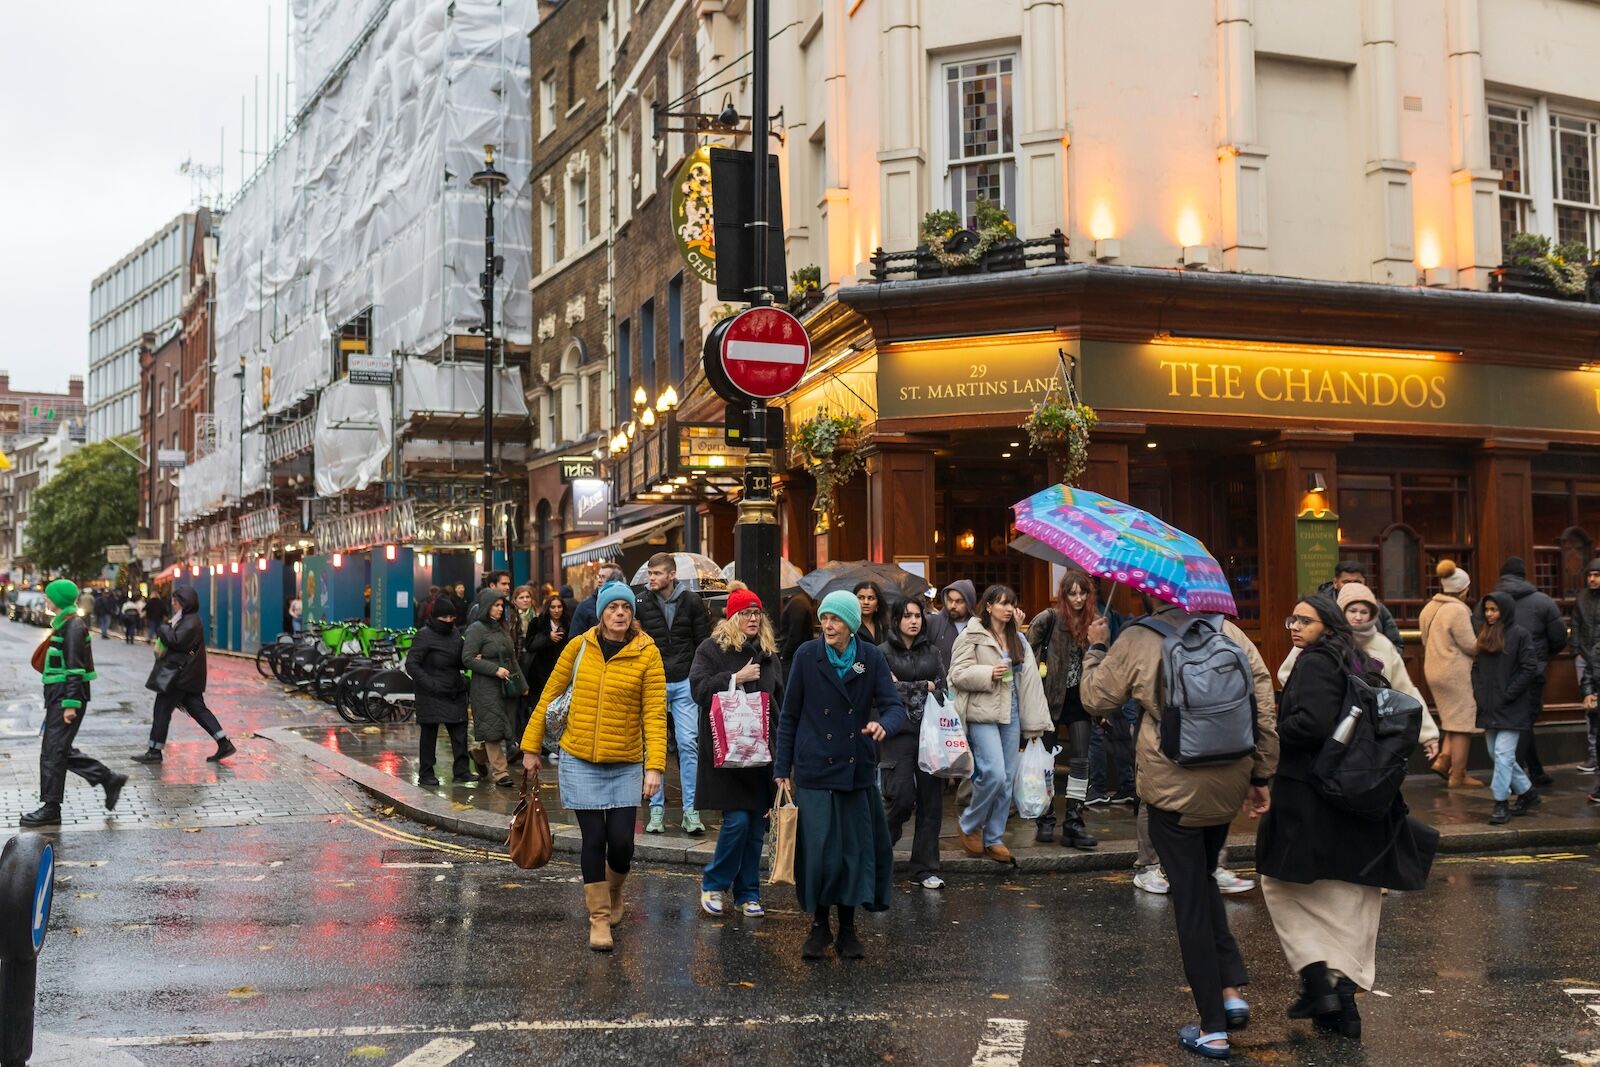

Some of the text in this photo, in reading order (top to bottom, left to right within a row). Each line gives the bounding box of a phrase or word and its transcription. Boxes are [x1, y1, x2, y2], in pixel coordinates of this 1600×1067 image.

[687, 251, 716, 281] CHA
[969, 364, 987, 378] 29
[1159, 359, 1447, 409] THE CHANDOS
[899, 377, 1059, 401] ST. MARTINS LANE
